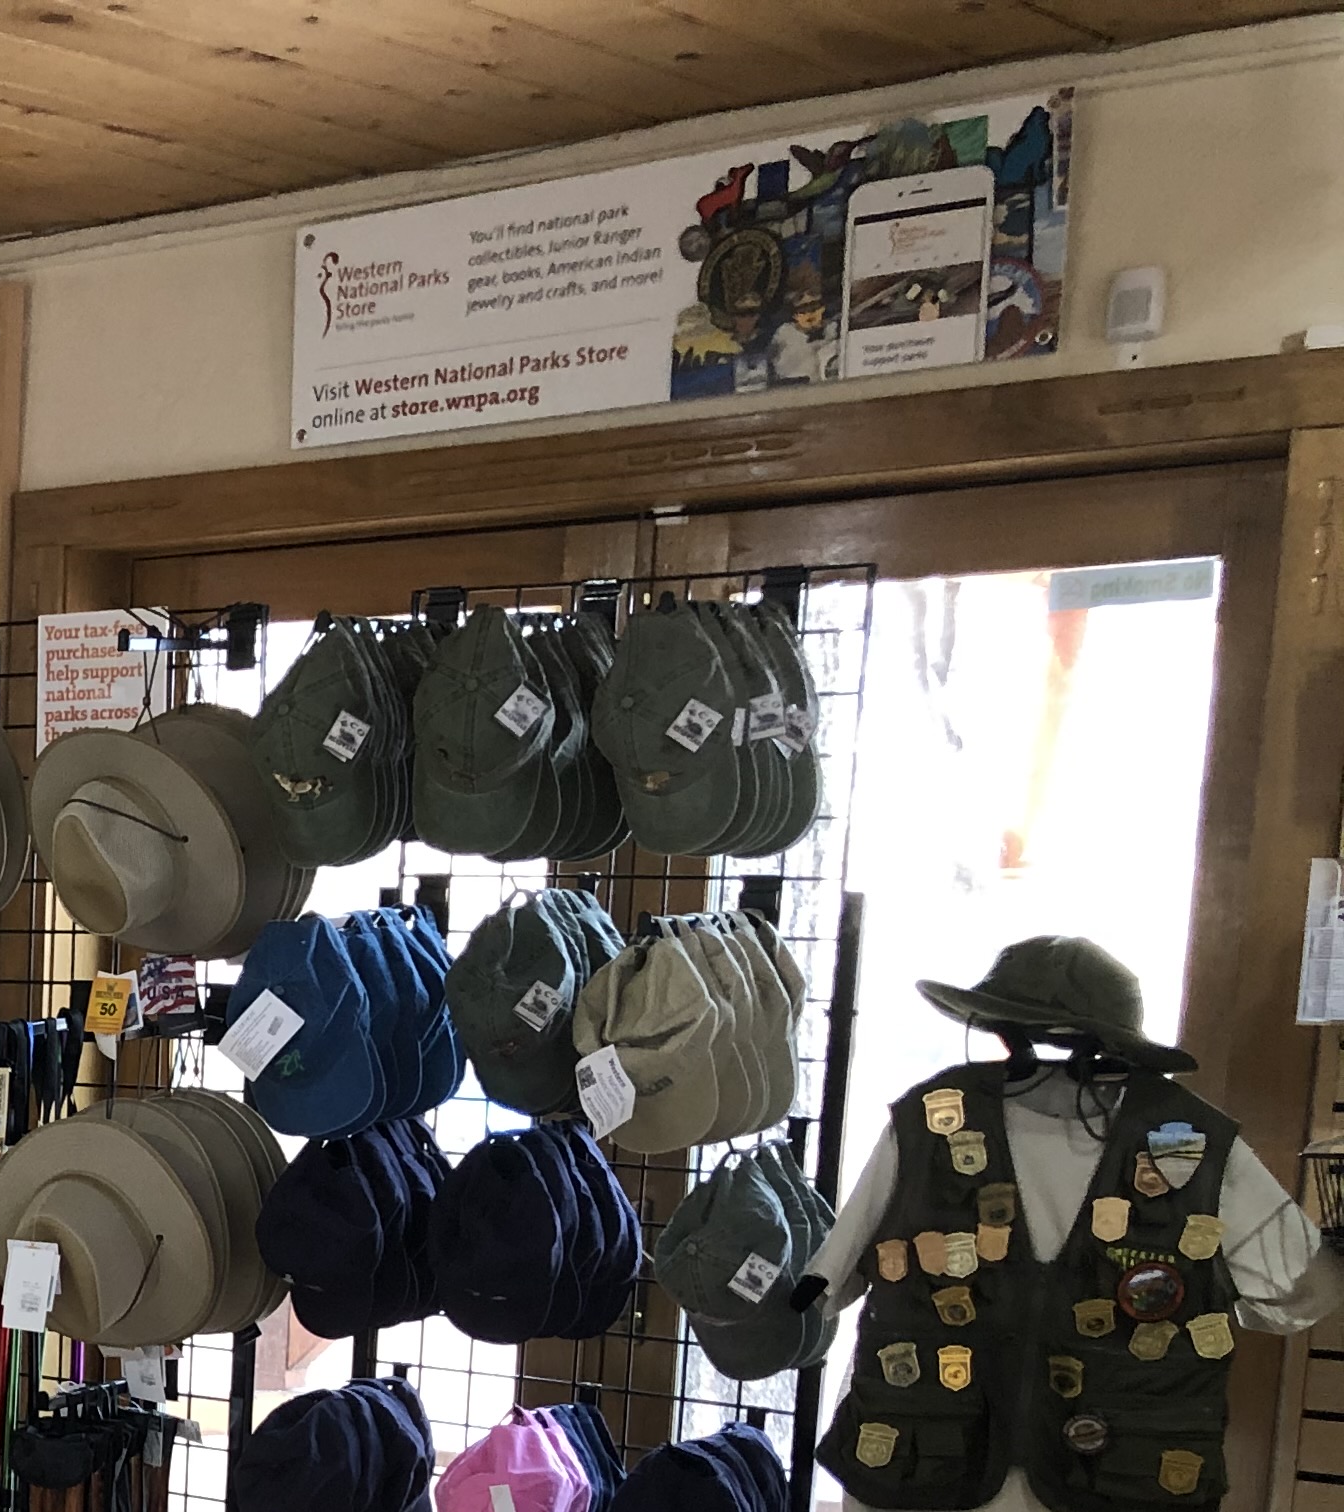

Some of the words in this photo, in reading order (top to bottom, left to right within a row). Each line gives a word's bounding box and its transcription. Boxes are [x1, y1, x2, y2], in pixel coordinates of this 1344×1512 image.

[509, 222, 534, 237] find
[537, 211, 595, 234] national
[597, 205, 629, 226] park
[548, 234, 591, 256] Junior
[593, 226, 642, 249] Ranger
[337, 258, 403, 283] Western
[547, 254, 613, 277] American
[616, 245, 662, 265] Indian
[336, 277, 404, 301] National
[407, 270, 451, 290] Parks
[466, 293, 514, 318] jewelry
[516, 287, 544, 305] and
[591, 275, 618, 293] and
[621, 267, 664, 288] more!
[336, 301, 377, 320] Store
[313, 382, 349, 402] Visit
[355, 373, 430, 397] Western
[434, 359, 513, 386] National
[519, 351, 571, 374] Parks
[576, 344, 629, 368] Store
[312, 407, 366, 430] online
[369, 405, 387, 422] at
[391, 385, 540, 420] store.wnpa.org
[44, 626, 80, 641] Your
[46, 664, 80, 684] help
[82, 661, 143, 683] support
[45, 685, 112, 703] national
[44, 706, 88, 726] parks
[90, 705, 139, 721] across
